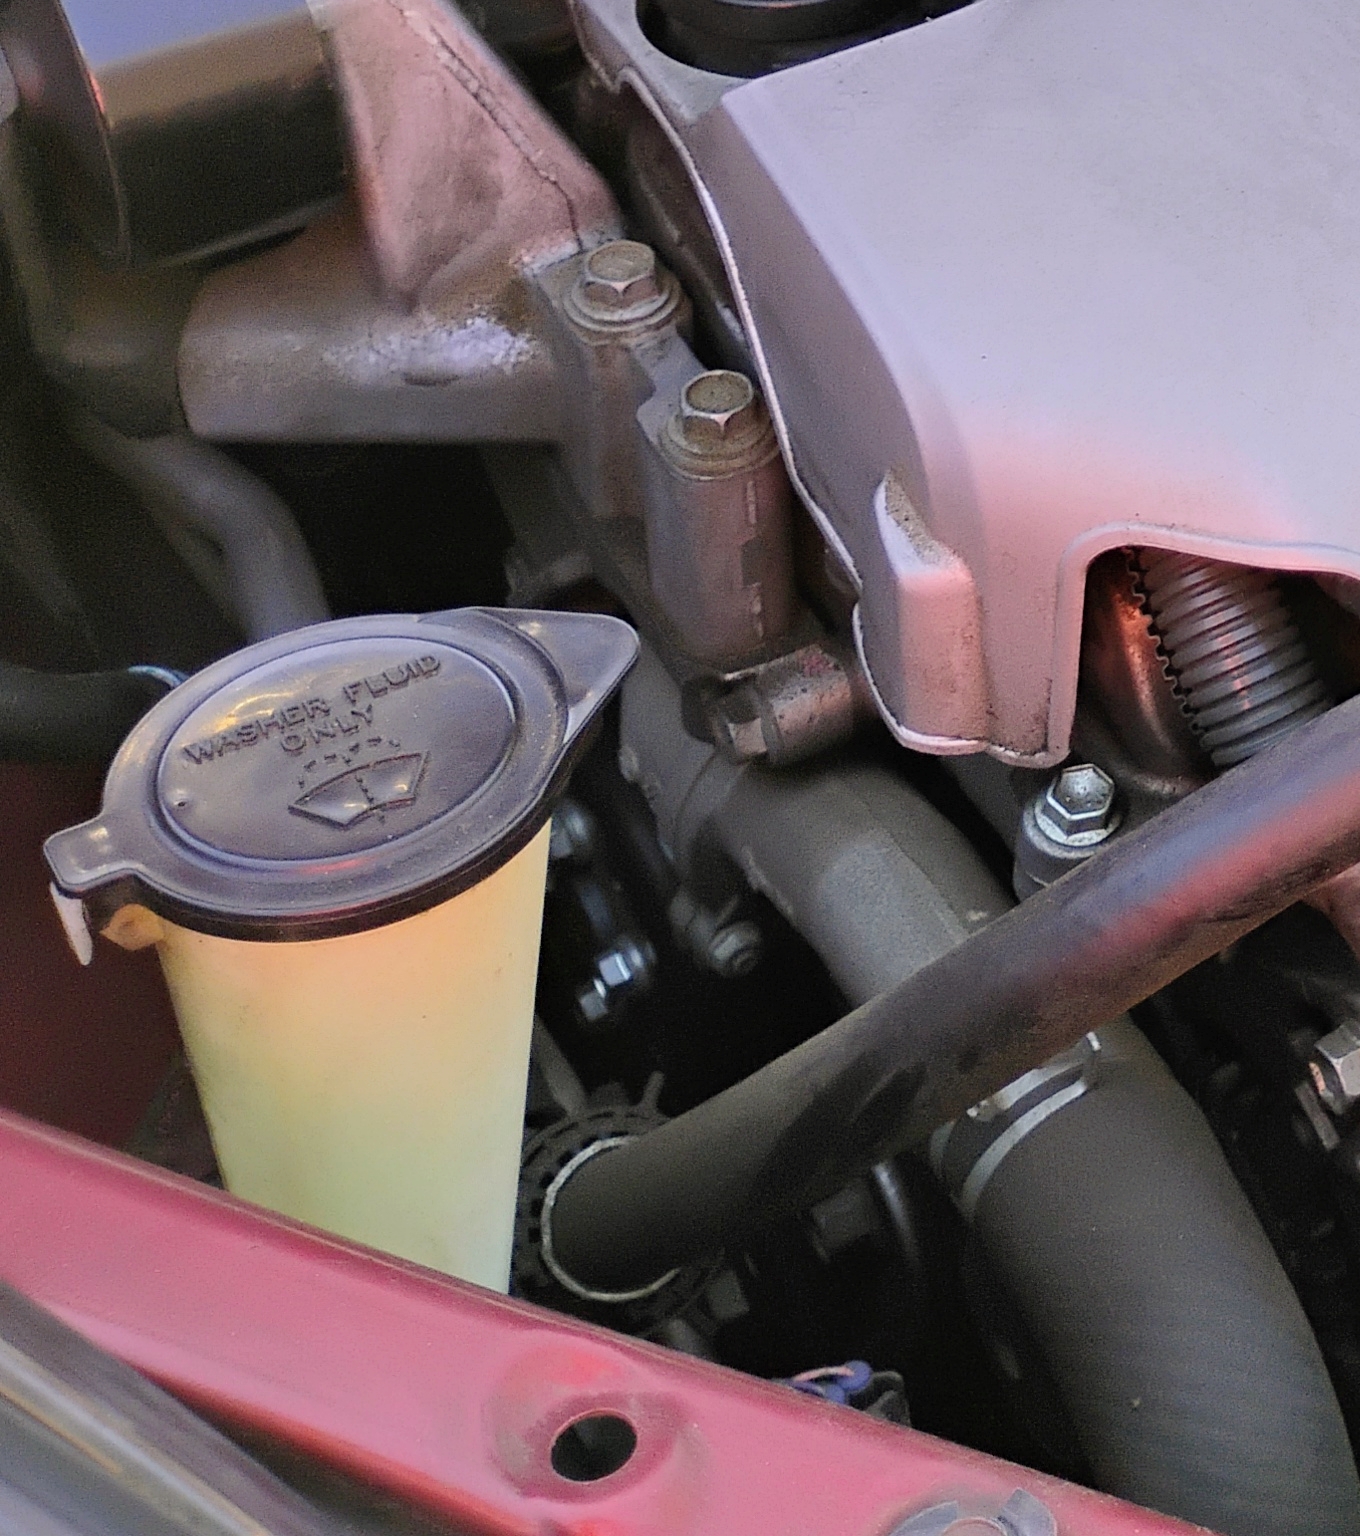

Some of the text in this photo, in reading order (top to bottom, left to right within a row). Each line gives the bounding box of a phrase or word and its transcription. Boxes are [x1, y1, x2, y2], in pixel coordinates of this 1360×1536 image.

[182, 654, 443, 766] WASHER FLUID
[279, 706, 374, 756] ONLY
